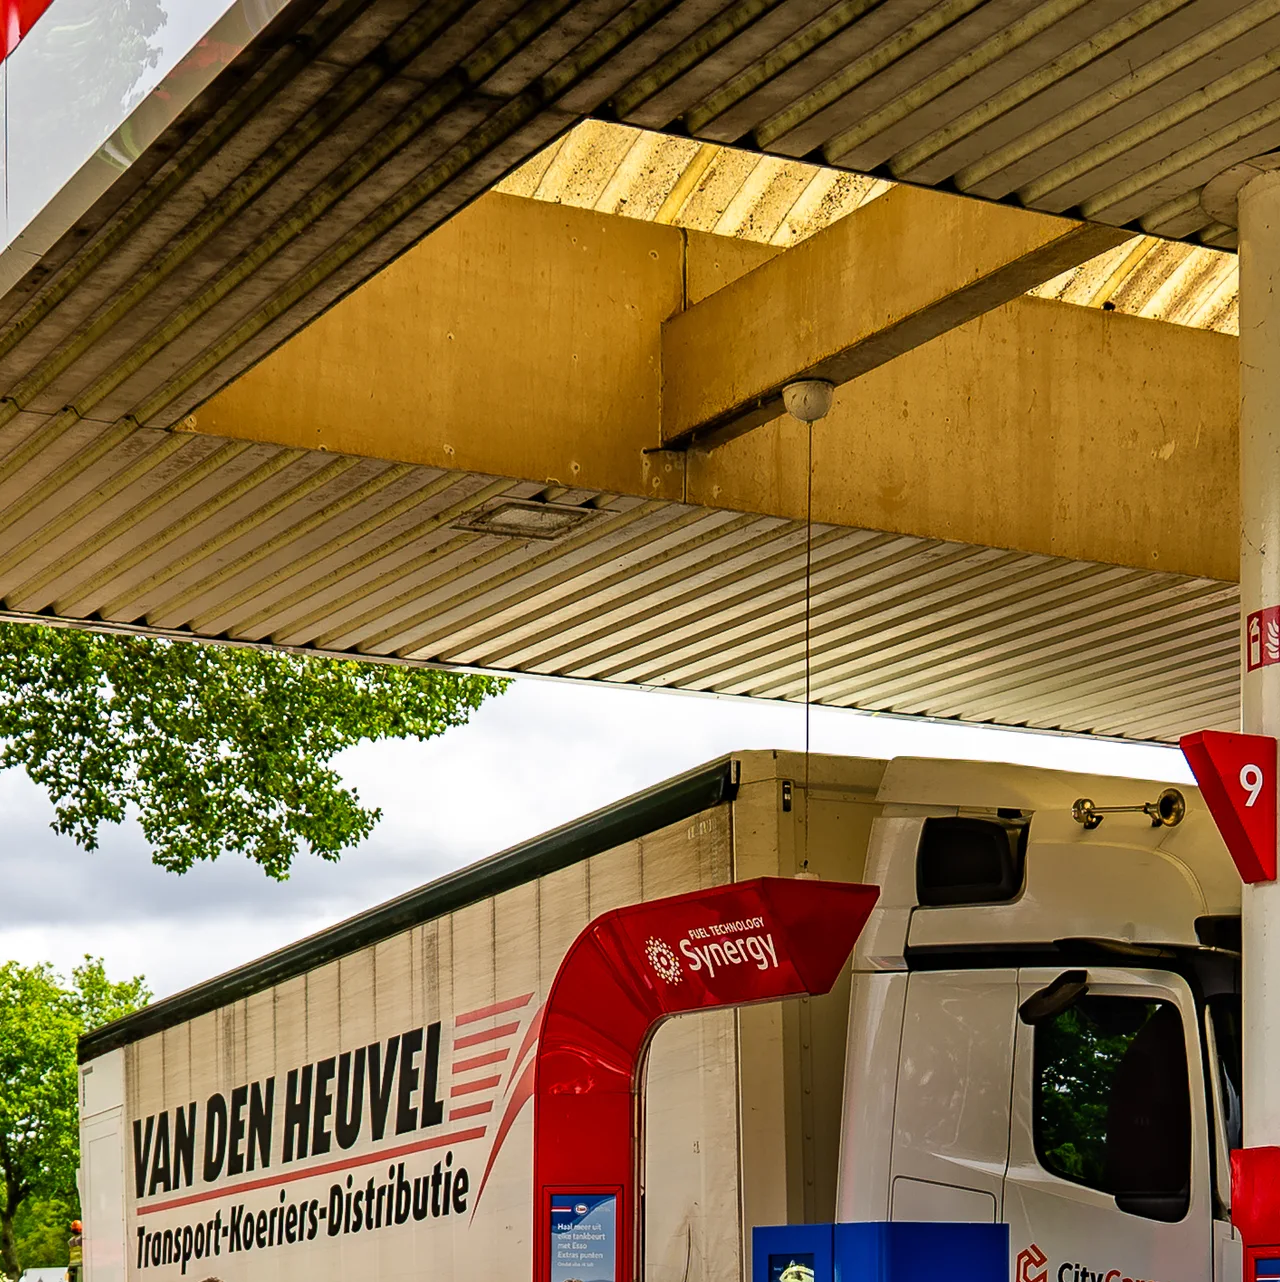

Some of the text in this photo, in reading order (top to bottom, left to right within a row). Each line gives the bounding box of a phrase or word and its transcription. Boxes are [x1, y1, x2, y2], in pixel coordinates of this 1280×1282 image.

[1239, 764, 1264, 806] 9
[688, 916, 764, 940] FUEL TECHNOLOGY
[679, 933, 779, 978] Synergy
[133, 1020, 444, 1199] VAN DEN HEUVEL
[136, 1150, 469, 1275] Transport-Koeriers-Distributie
[557, 1222, 573, 1230] Haal
